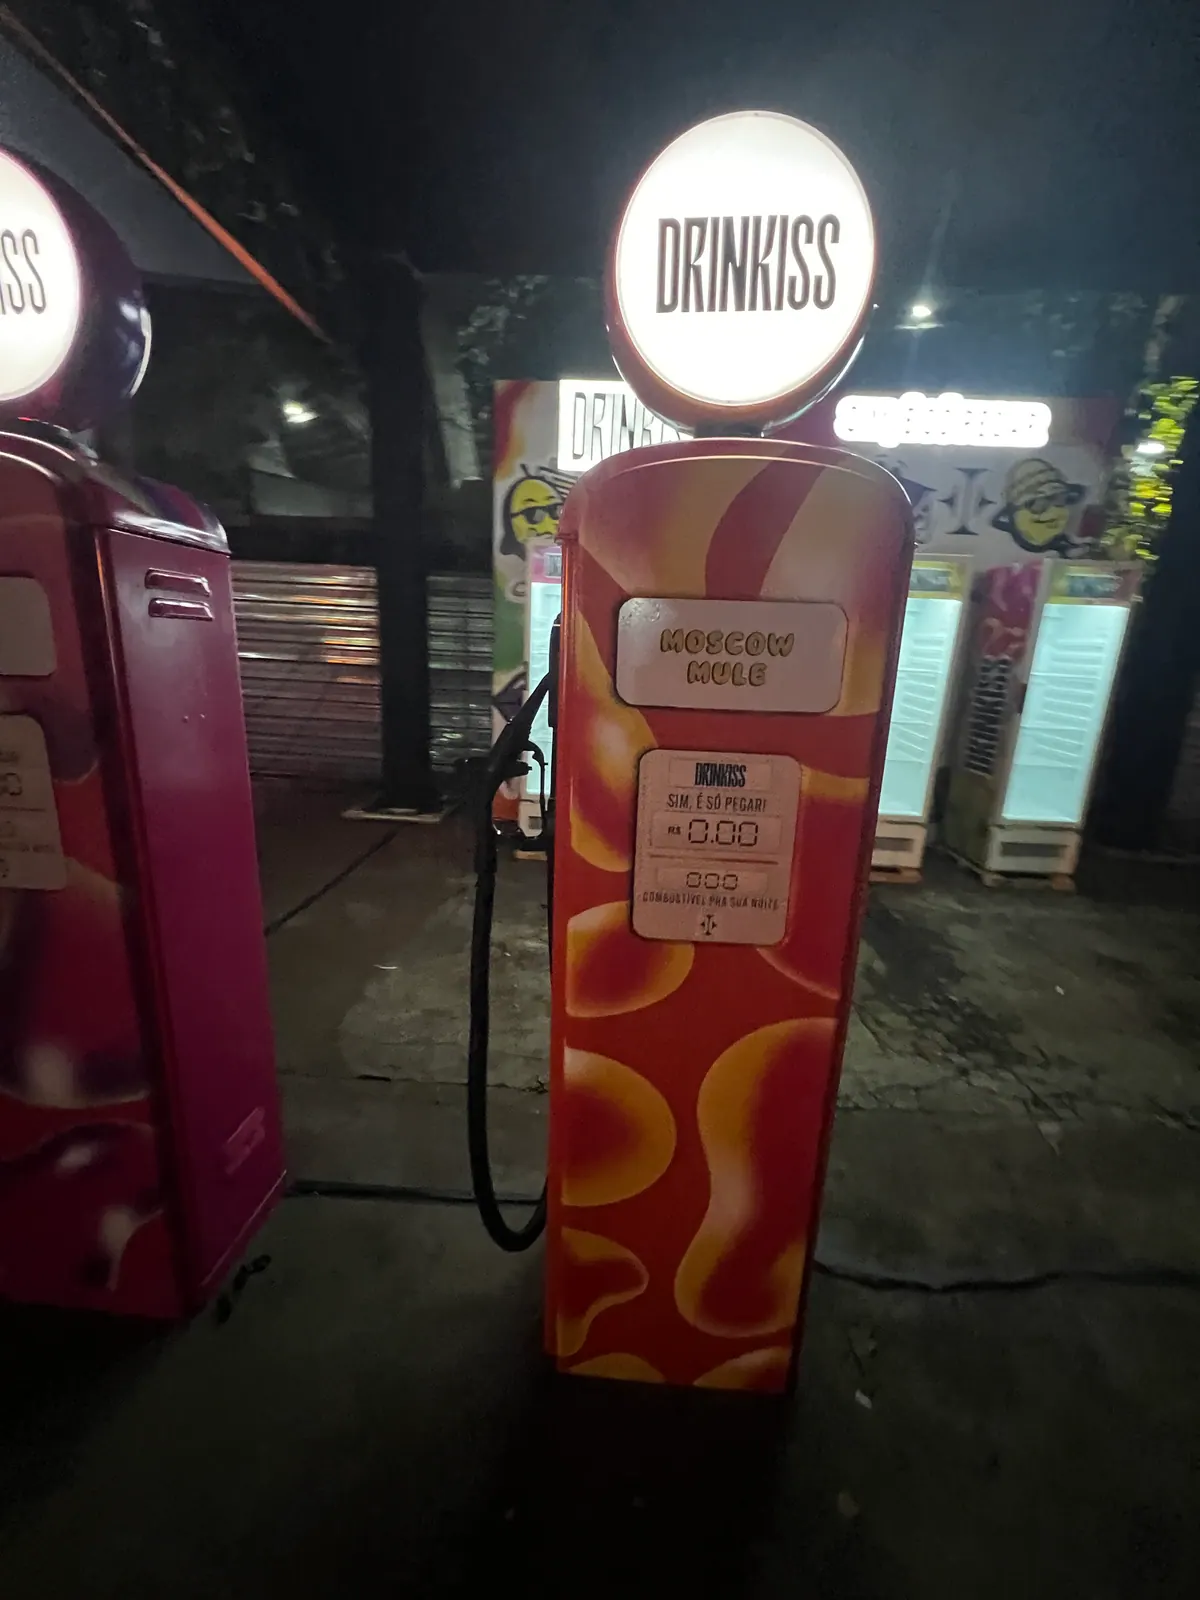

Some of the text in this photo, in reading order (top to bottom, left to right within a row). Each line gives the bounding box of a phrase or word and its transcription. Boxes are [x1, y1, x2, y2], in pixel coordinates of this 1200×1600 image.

[656, 213, 841, 313] DRINKISS
[572, 391, 681, 461] DRINK
[660, 628, 795, 656] MOSCOW
[687, 660, 767, 687] MULE
[694, 762, 747, 788] DRINKISS
[667, 792, 767, 813] SIM, É SÓ PEGAR!
[688, 819, 759, 846] 0.00
[686, 871, 739, 890] 000
